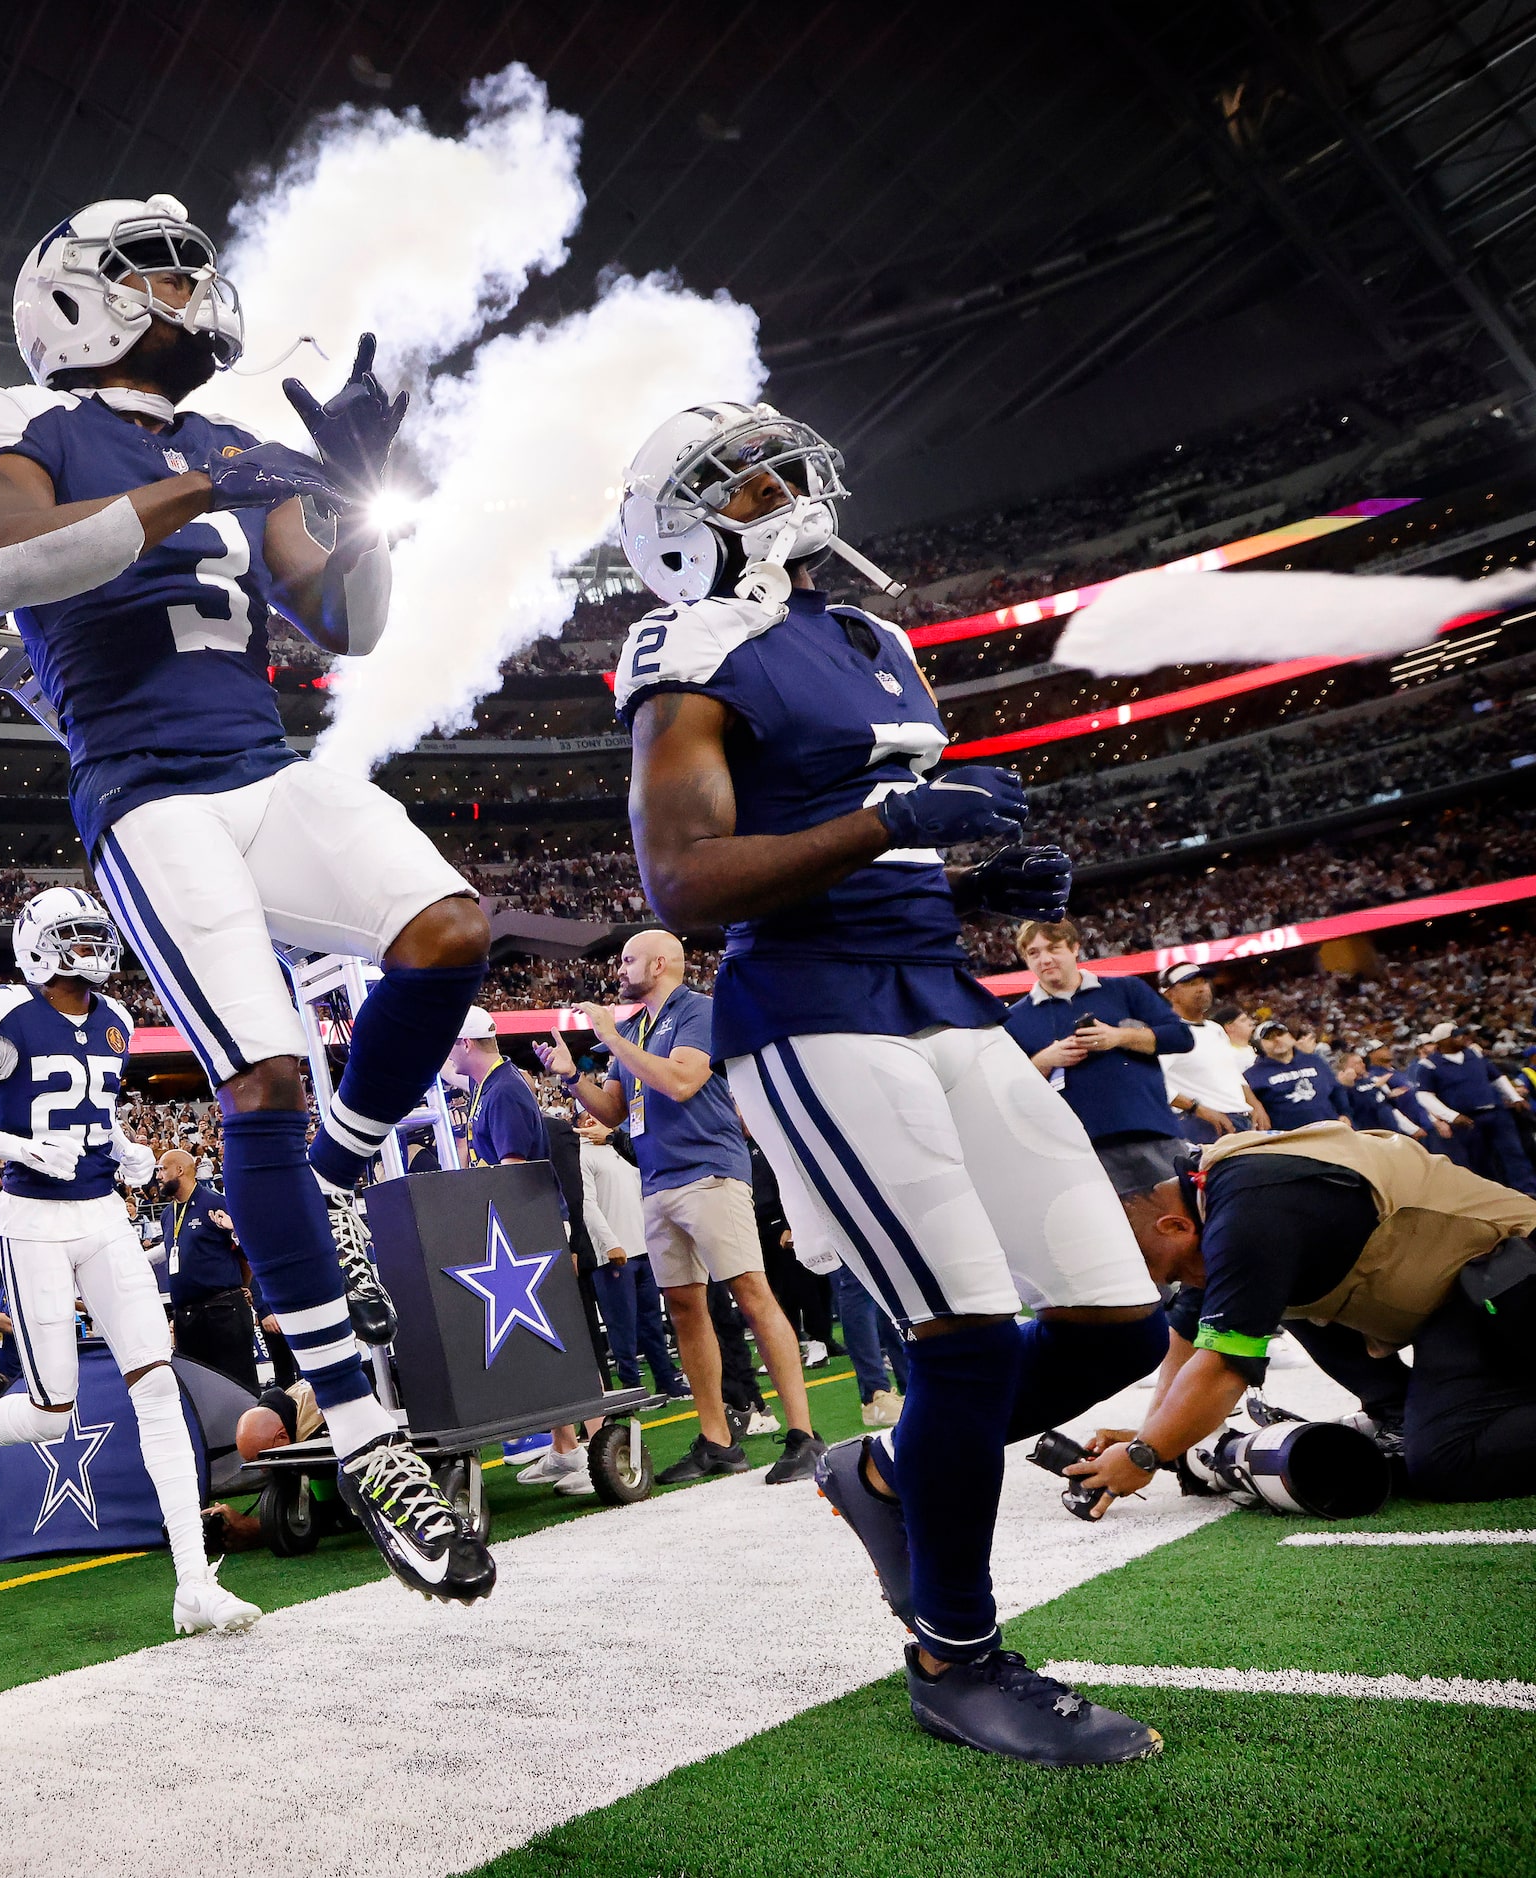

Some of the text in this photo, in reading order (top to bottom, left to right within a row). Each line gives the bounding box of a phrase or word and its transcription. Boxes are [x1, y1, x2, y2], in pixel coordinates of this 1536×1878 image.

[167, 510, 252, 653] 3
[631, 625, 668, 678] 2
[576, 737, 602, 749] TONY
[862, 722, 950, 864] 2
[31, 1054, 123, 1147] 25
